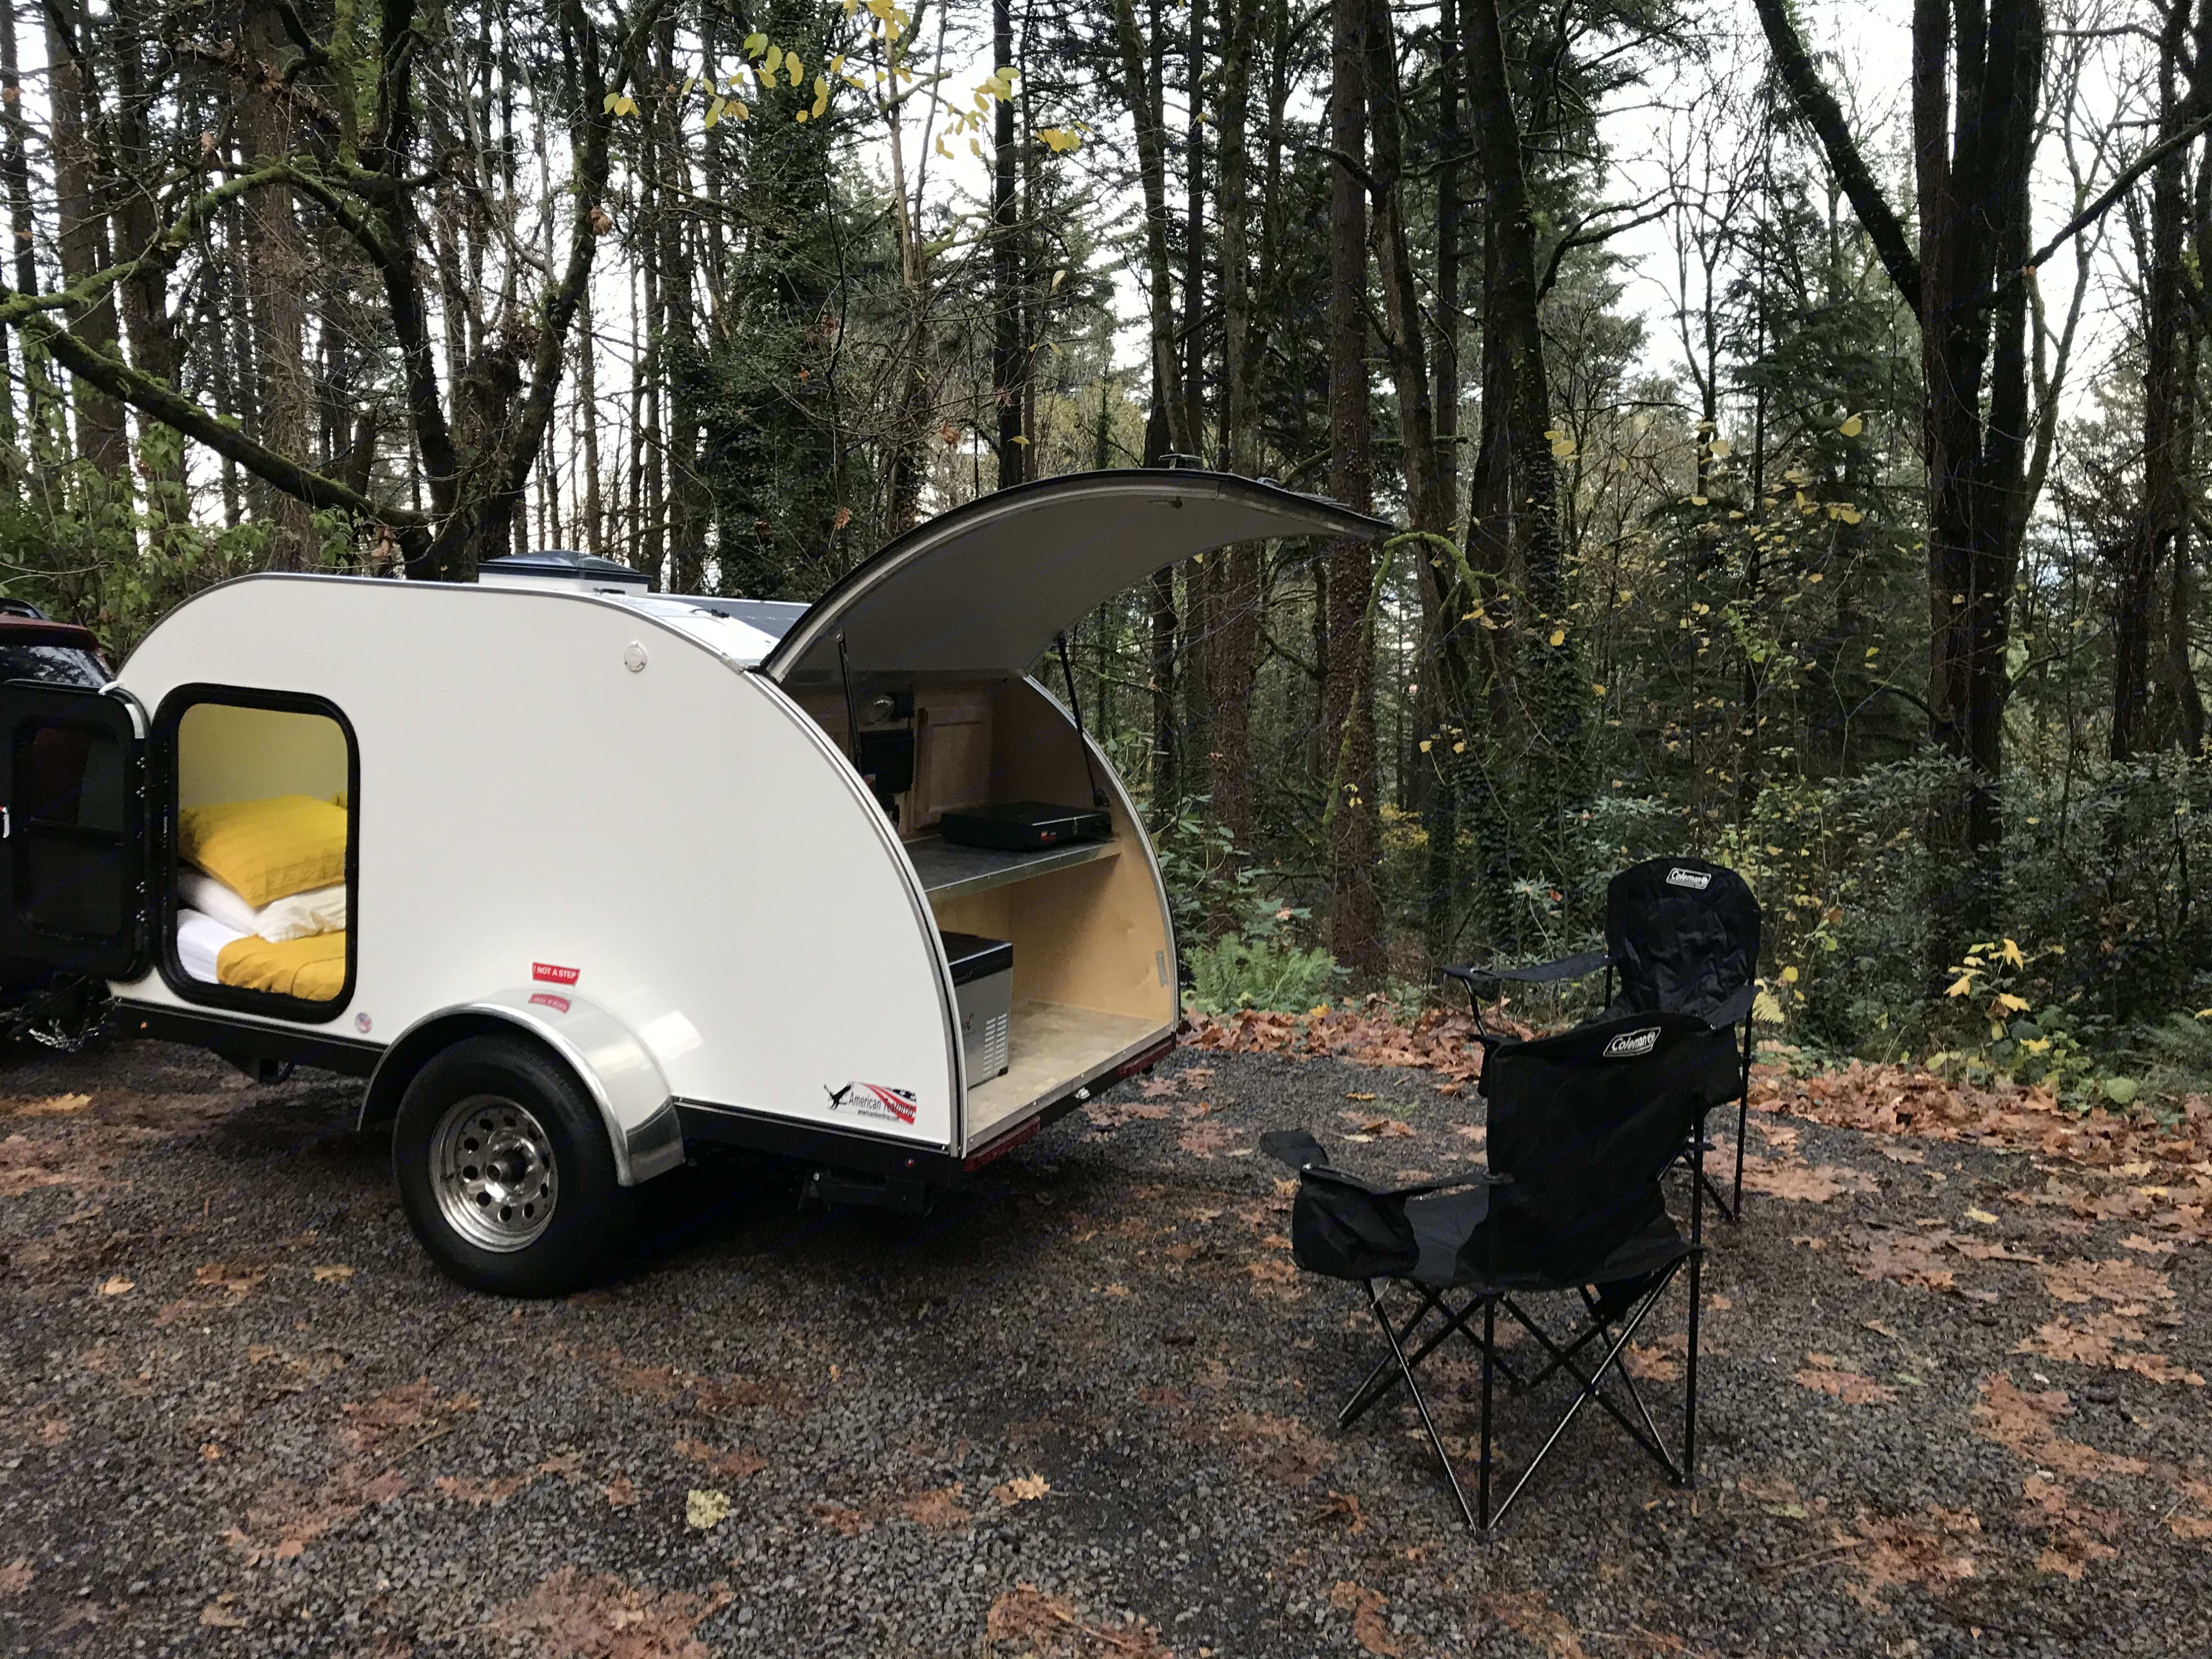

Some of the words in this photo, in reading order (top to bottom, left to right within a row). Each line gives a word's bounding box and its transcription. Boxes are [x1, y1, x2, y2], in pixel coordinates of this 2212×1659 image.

[1671, 870, 1702, 885] Coleman
[537, 966, 552, 975] NOT
[552, 968, 558, 977] A
[559, 969, 576, 979] STEP
[1611, 1035, 1647, 1052] Coleman
[848, 1091, 881, 1110] American
